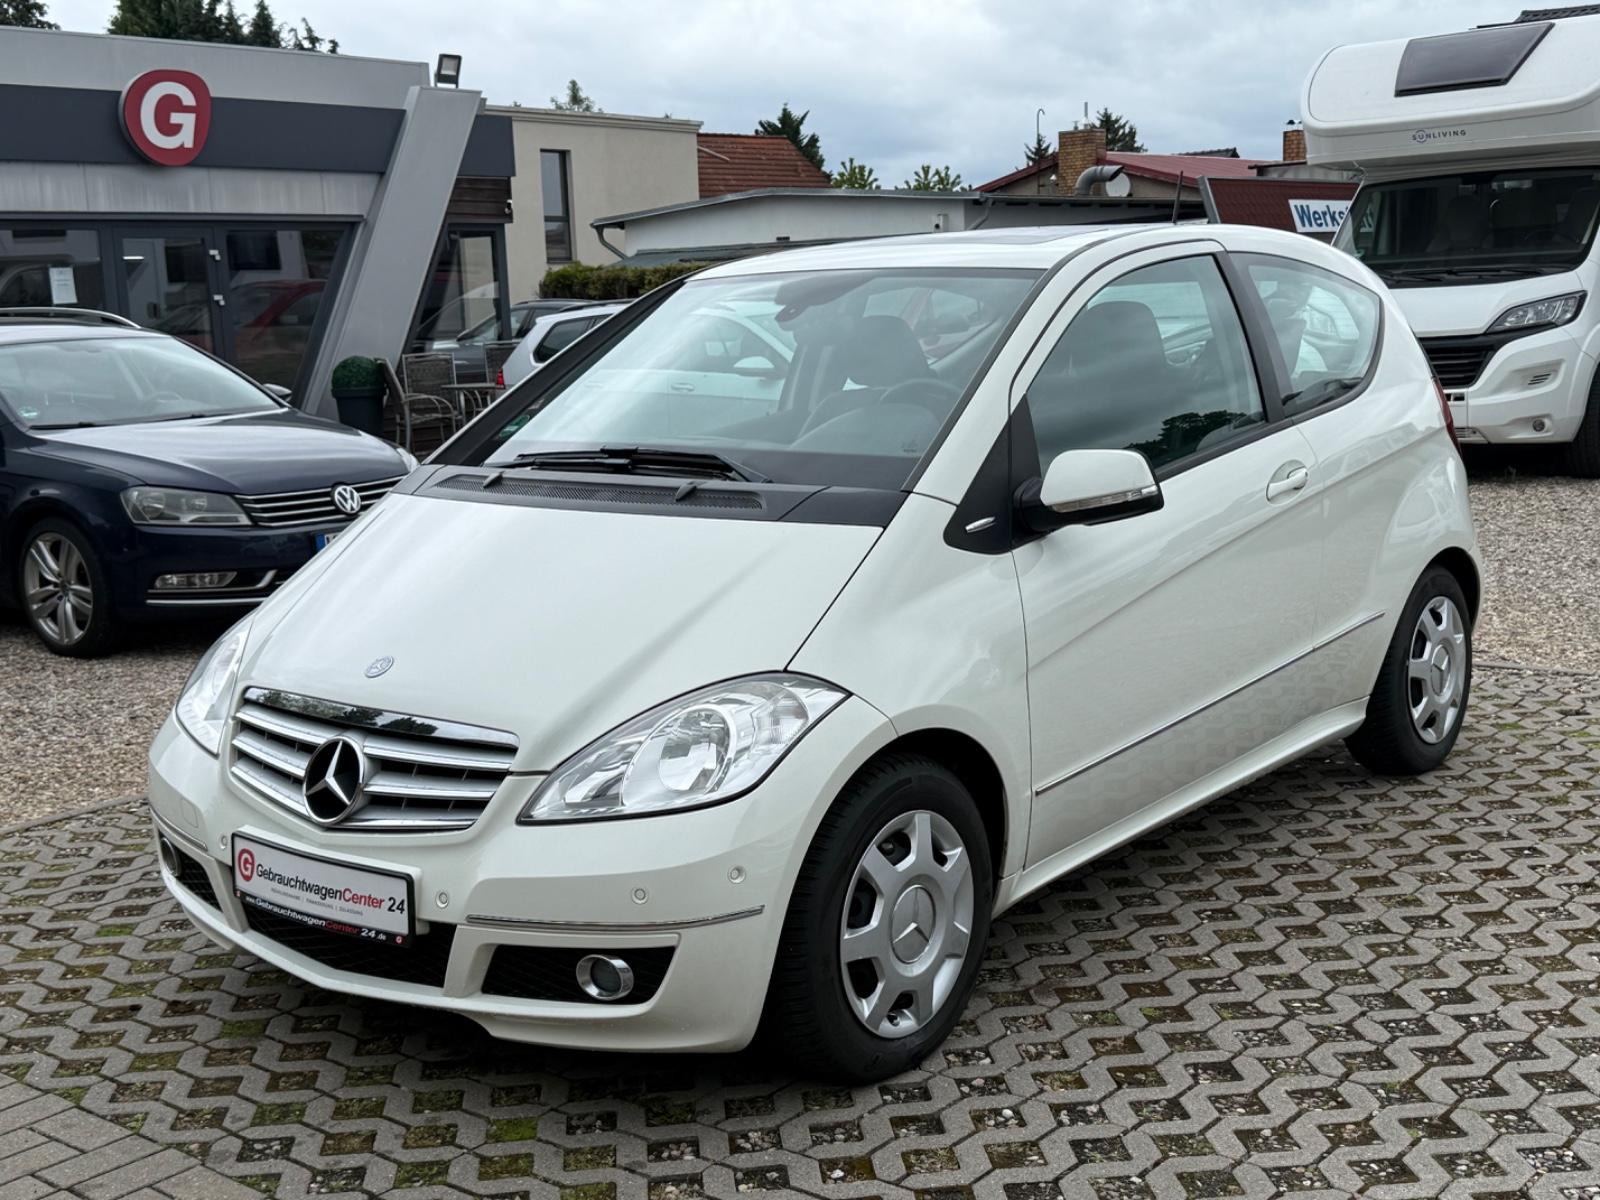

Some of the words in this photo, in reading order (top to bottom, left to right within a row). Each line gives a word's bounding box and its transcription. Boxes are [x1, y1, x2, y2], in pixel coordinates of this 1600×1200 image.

[140, 80, 197, 149] G
[1412, 129, 1467, 143] SUNLIVING
[240, 852, 253, 877] G
[256, 863, 385, 909] GebrauchtwagenCenter
[387, 896, 405, 914] 24
